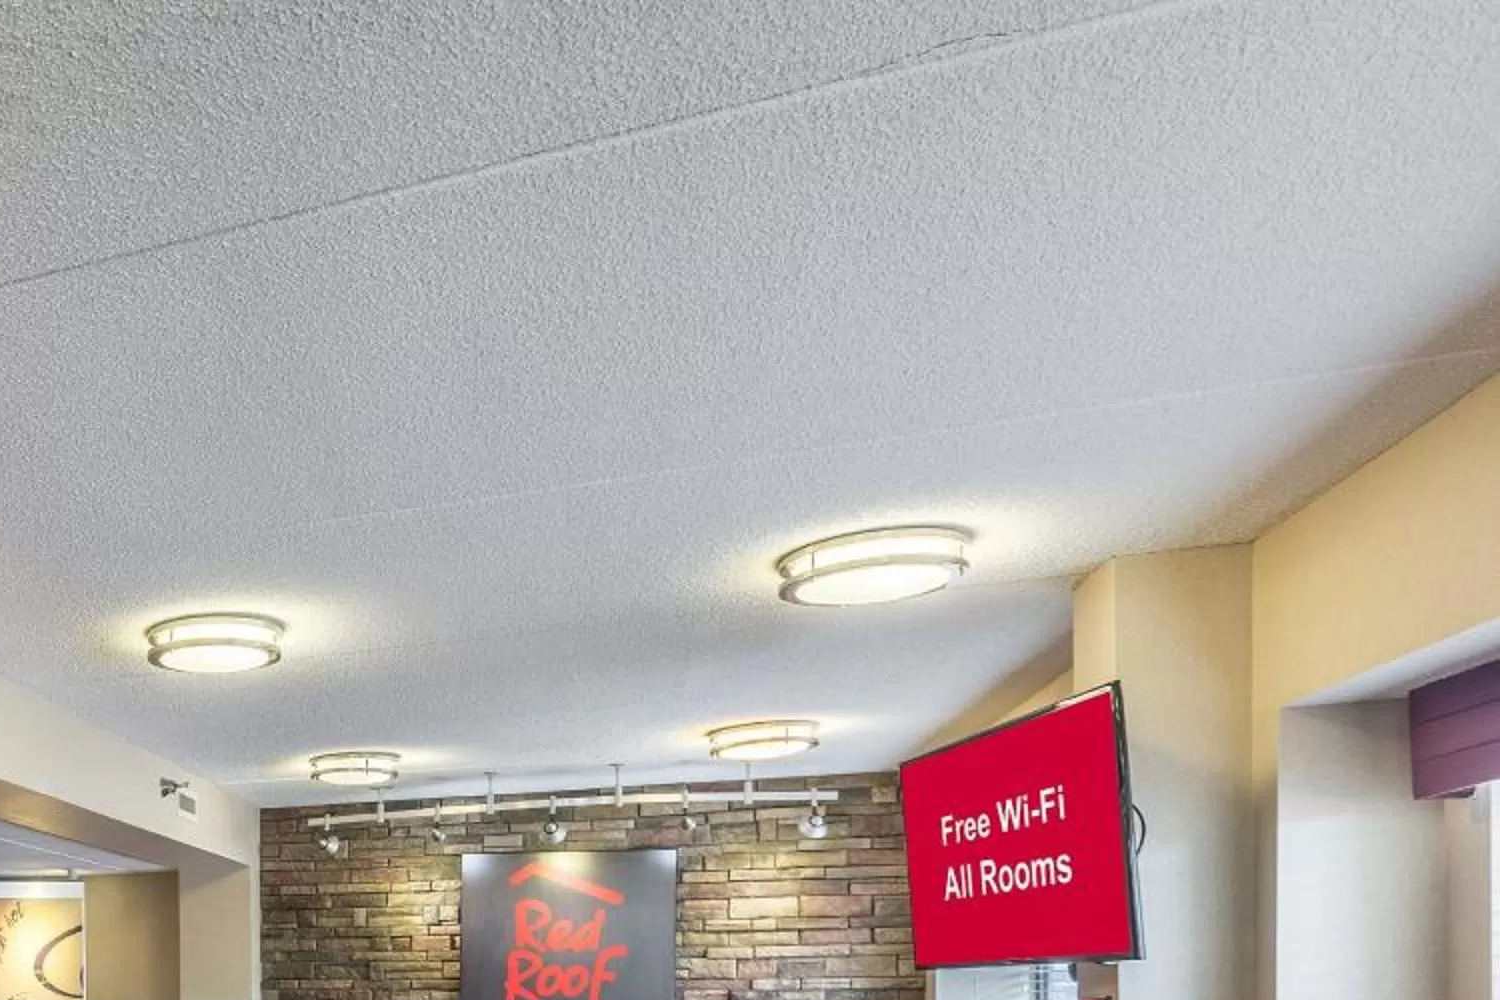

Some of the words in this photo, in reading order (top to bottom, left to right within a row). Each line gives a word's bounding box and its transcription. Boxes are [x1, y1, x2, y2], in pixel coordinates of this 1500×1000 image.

[940, 813, 992, 847] Free
[996, 784, 1067, 834] Wi-Fi
[943, 862, 974, 902] All
[979, 853, 1074, 896] Rooms
[514, 898, 608, 953] Red
